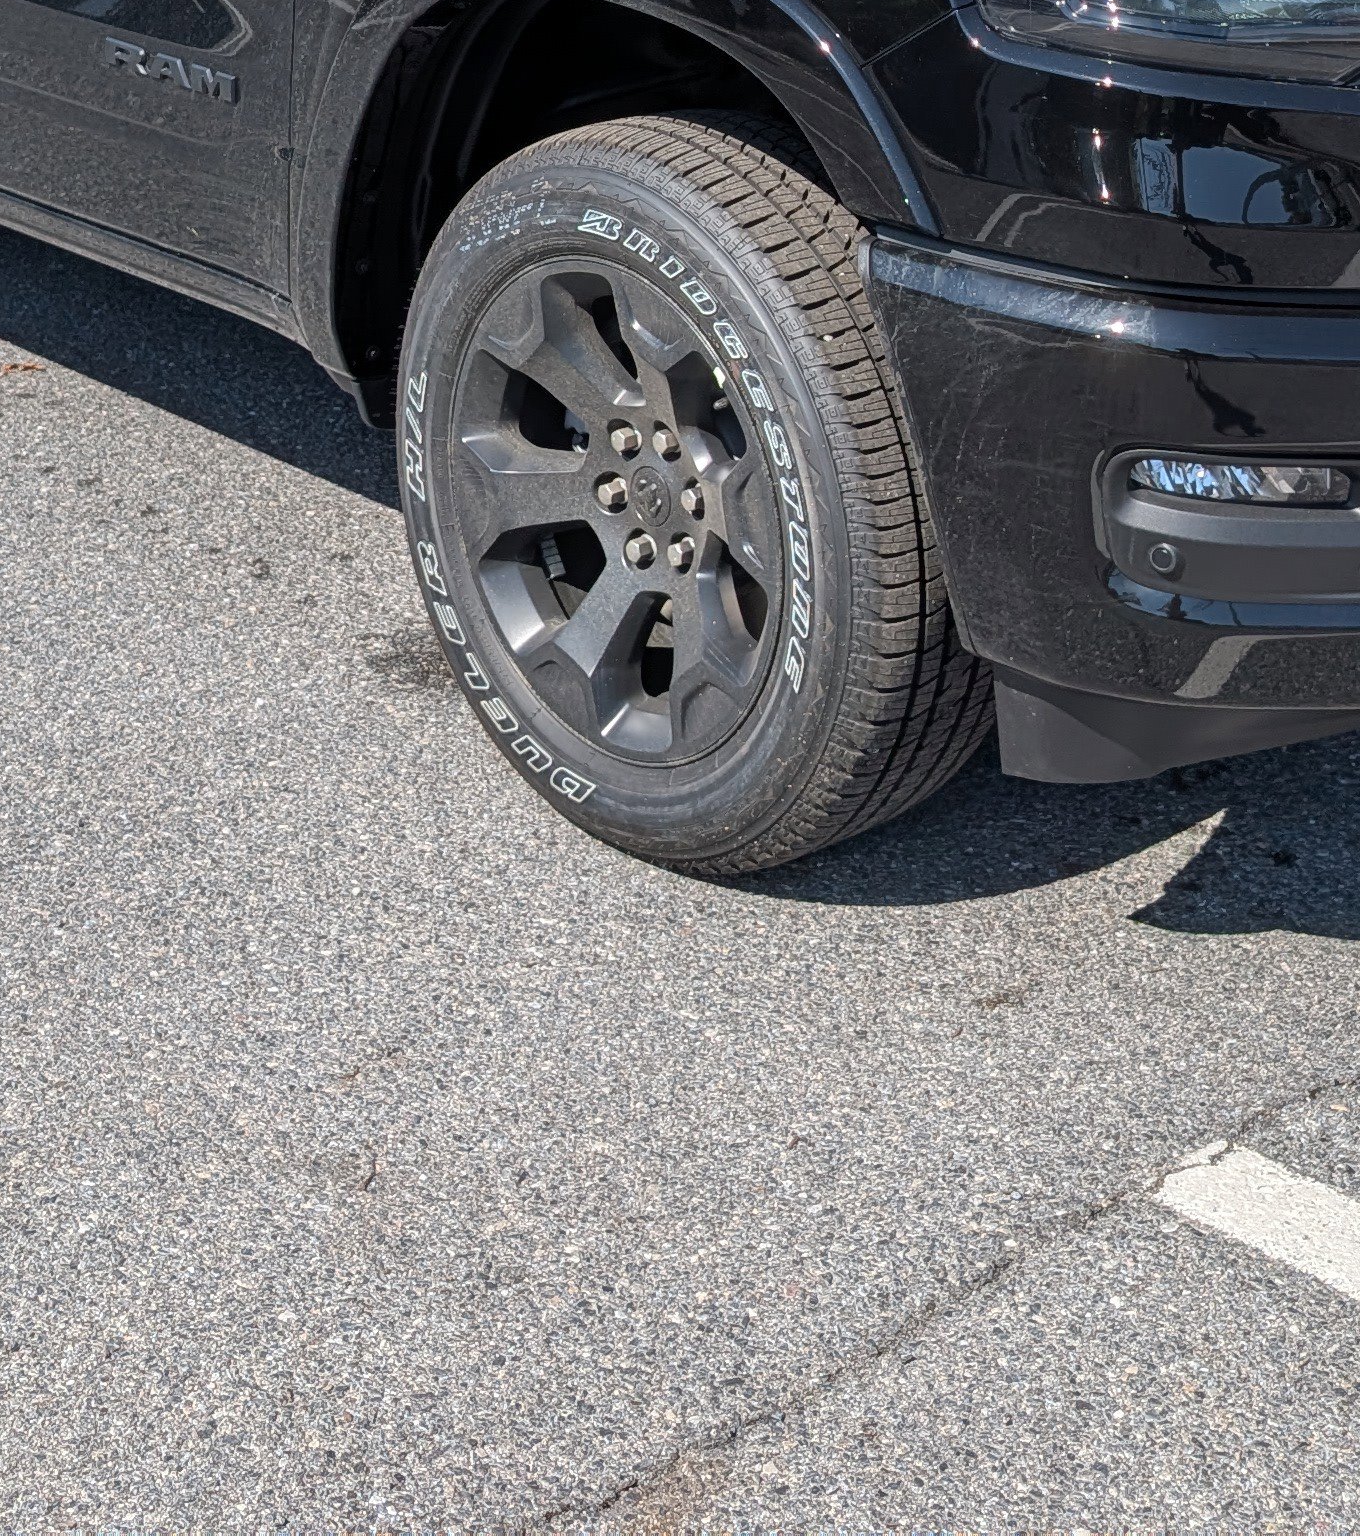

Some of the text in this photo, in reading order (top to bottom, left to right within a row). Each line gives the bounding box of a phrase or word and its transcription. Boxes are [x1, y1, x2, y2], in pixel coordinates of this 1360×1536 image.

[105, 36, 238, 105] RAM
[577, 209, 813, 693] BRIDGESTONE
[417, 538, 597, 803] DUELER
